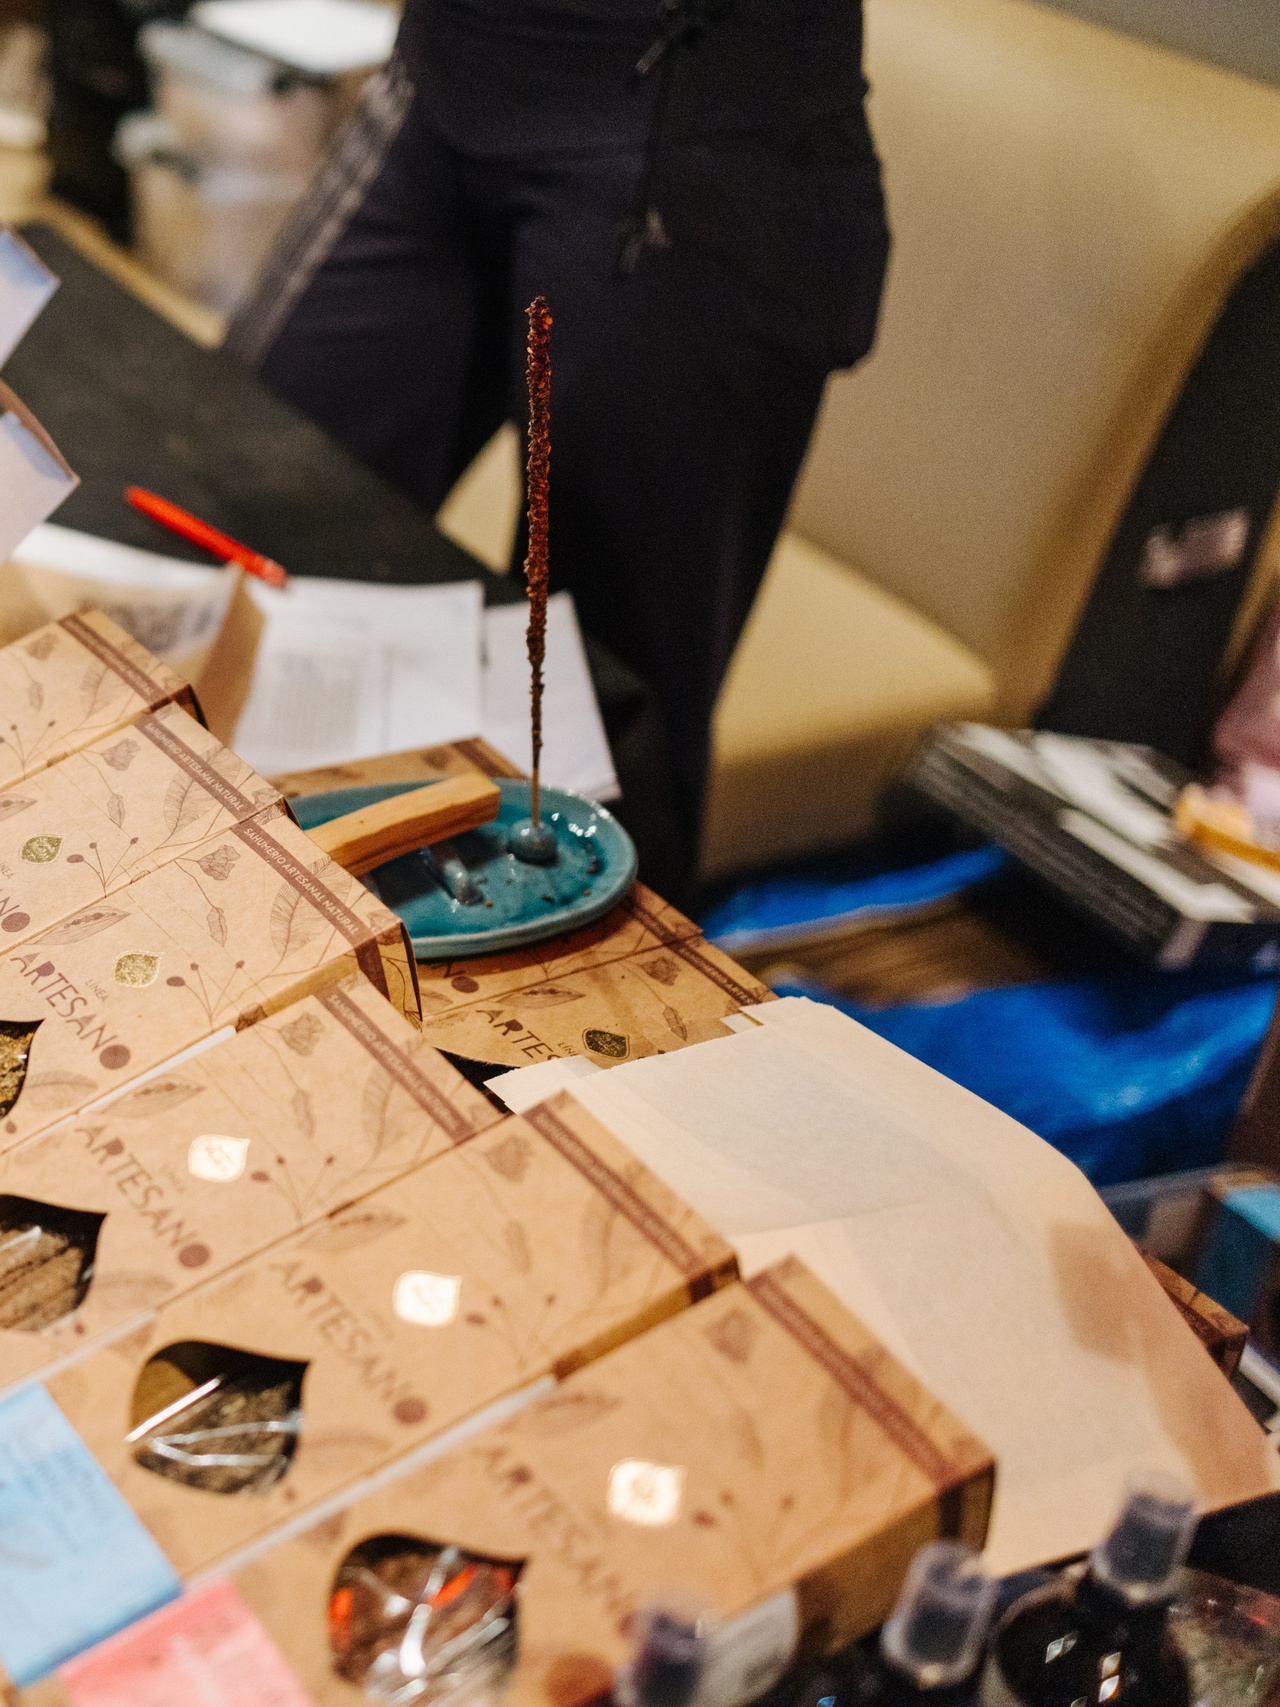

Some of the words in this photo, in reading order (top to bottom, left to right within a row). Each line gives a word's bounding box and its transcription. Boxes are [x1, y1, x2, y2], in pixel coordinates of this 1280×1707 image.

[144, 722, 183, 757] SAHUMERIO
[179, 752, 216, 785] ARTESANAL
[212, 781, 245, 811] NATURAL
[243, 828, 286, 864] SAHUMERIO
[281, 861, 325, 901] ARTESANAL
[322, 897, 360, 936] NATURAL
[10, 952, 132, 1070] ARTESANO
[85, 979, 109, 1002] LÍNEA
[75, 1125, 210, 1269] ARTESANO
[271, 1262, 429, 1425] ARTESANO
